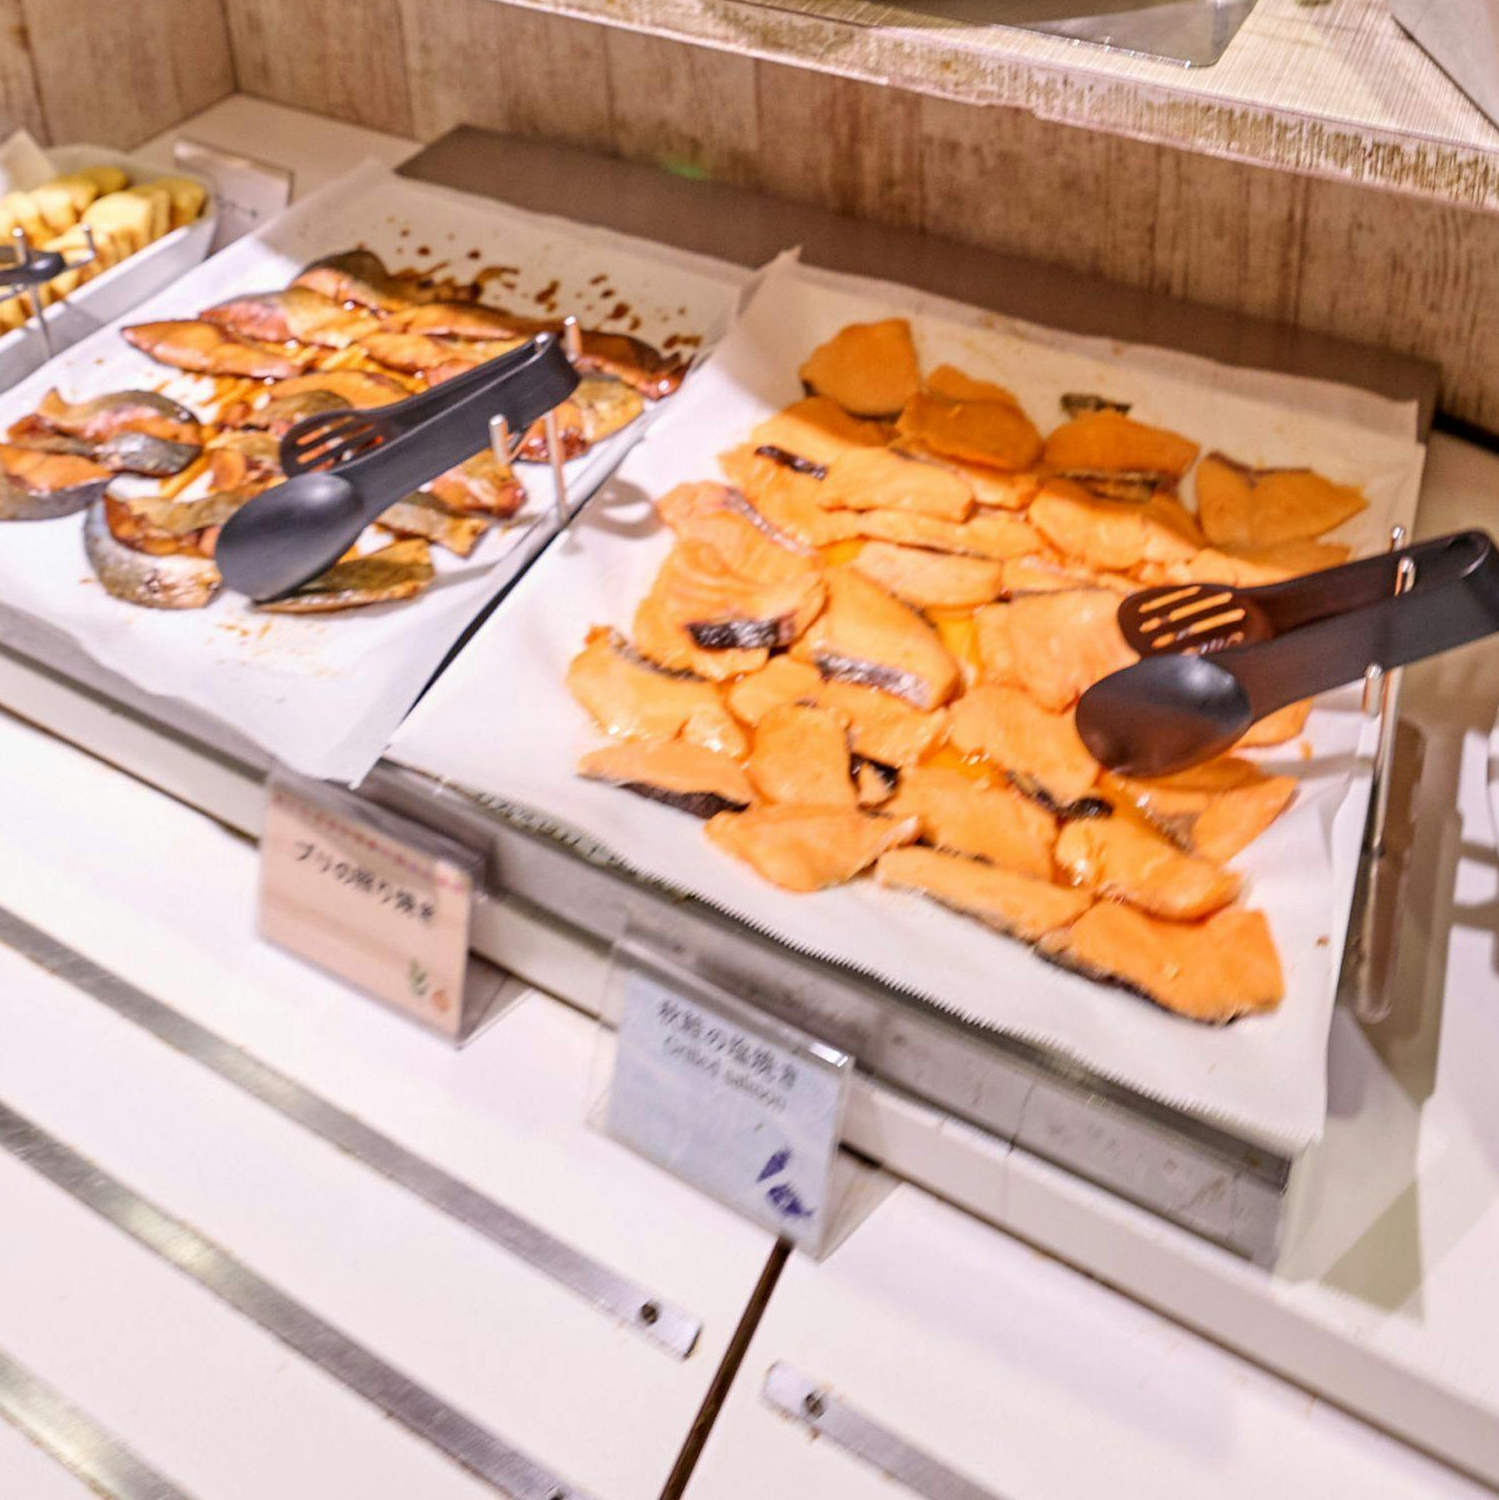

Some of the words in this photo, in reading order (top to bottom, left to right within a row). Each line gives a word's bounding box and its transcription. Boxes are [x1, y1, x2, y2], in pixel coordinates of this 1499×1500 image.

[295, 841, 436, 923] ブリの照り焼き
